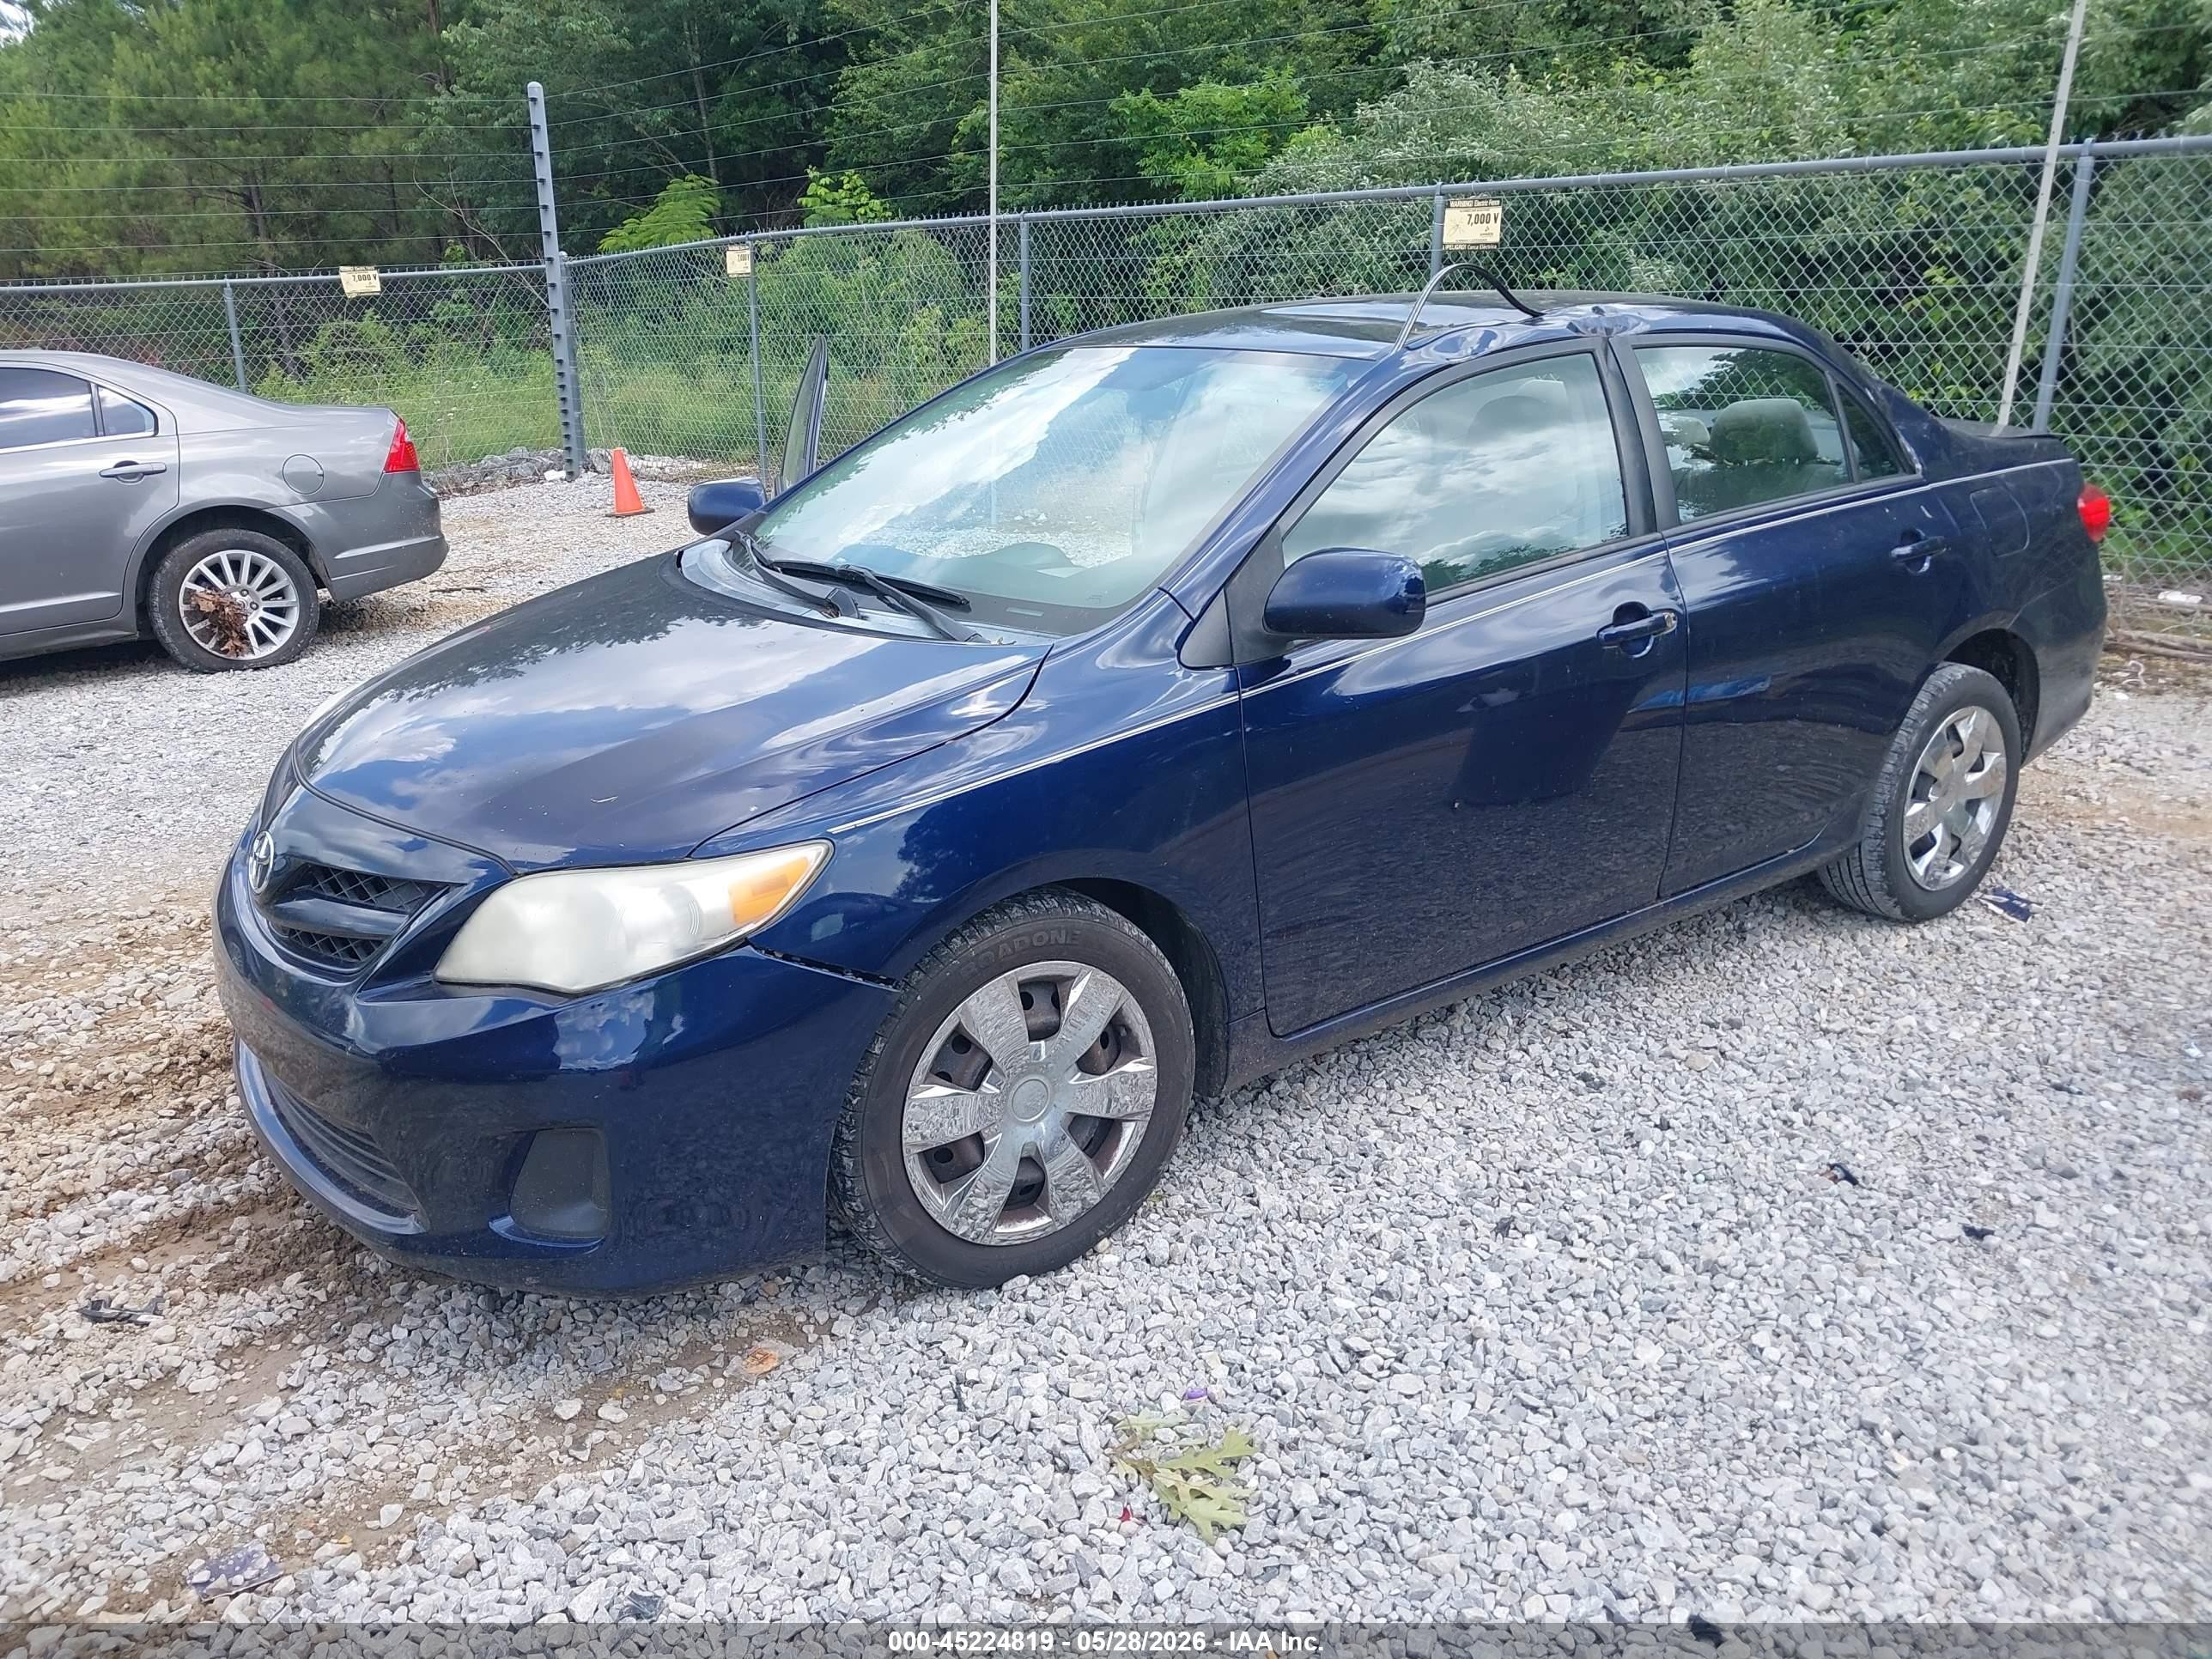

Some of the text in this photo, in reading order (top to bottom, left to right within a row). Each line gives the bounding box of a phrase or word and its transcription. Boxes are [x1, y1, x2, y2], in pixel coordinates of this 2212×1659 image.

[1467, 212, 1499, 227] 7,000 V
[352, 274, 372, 283] 7,000
